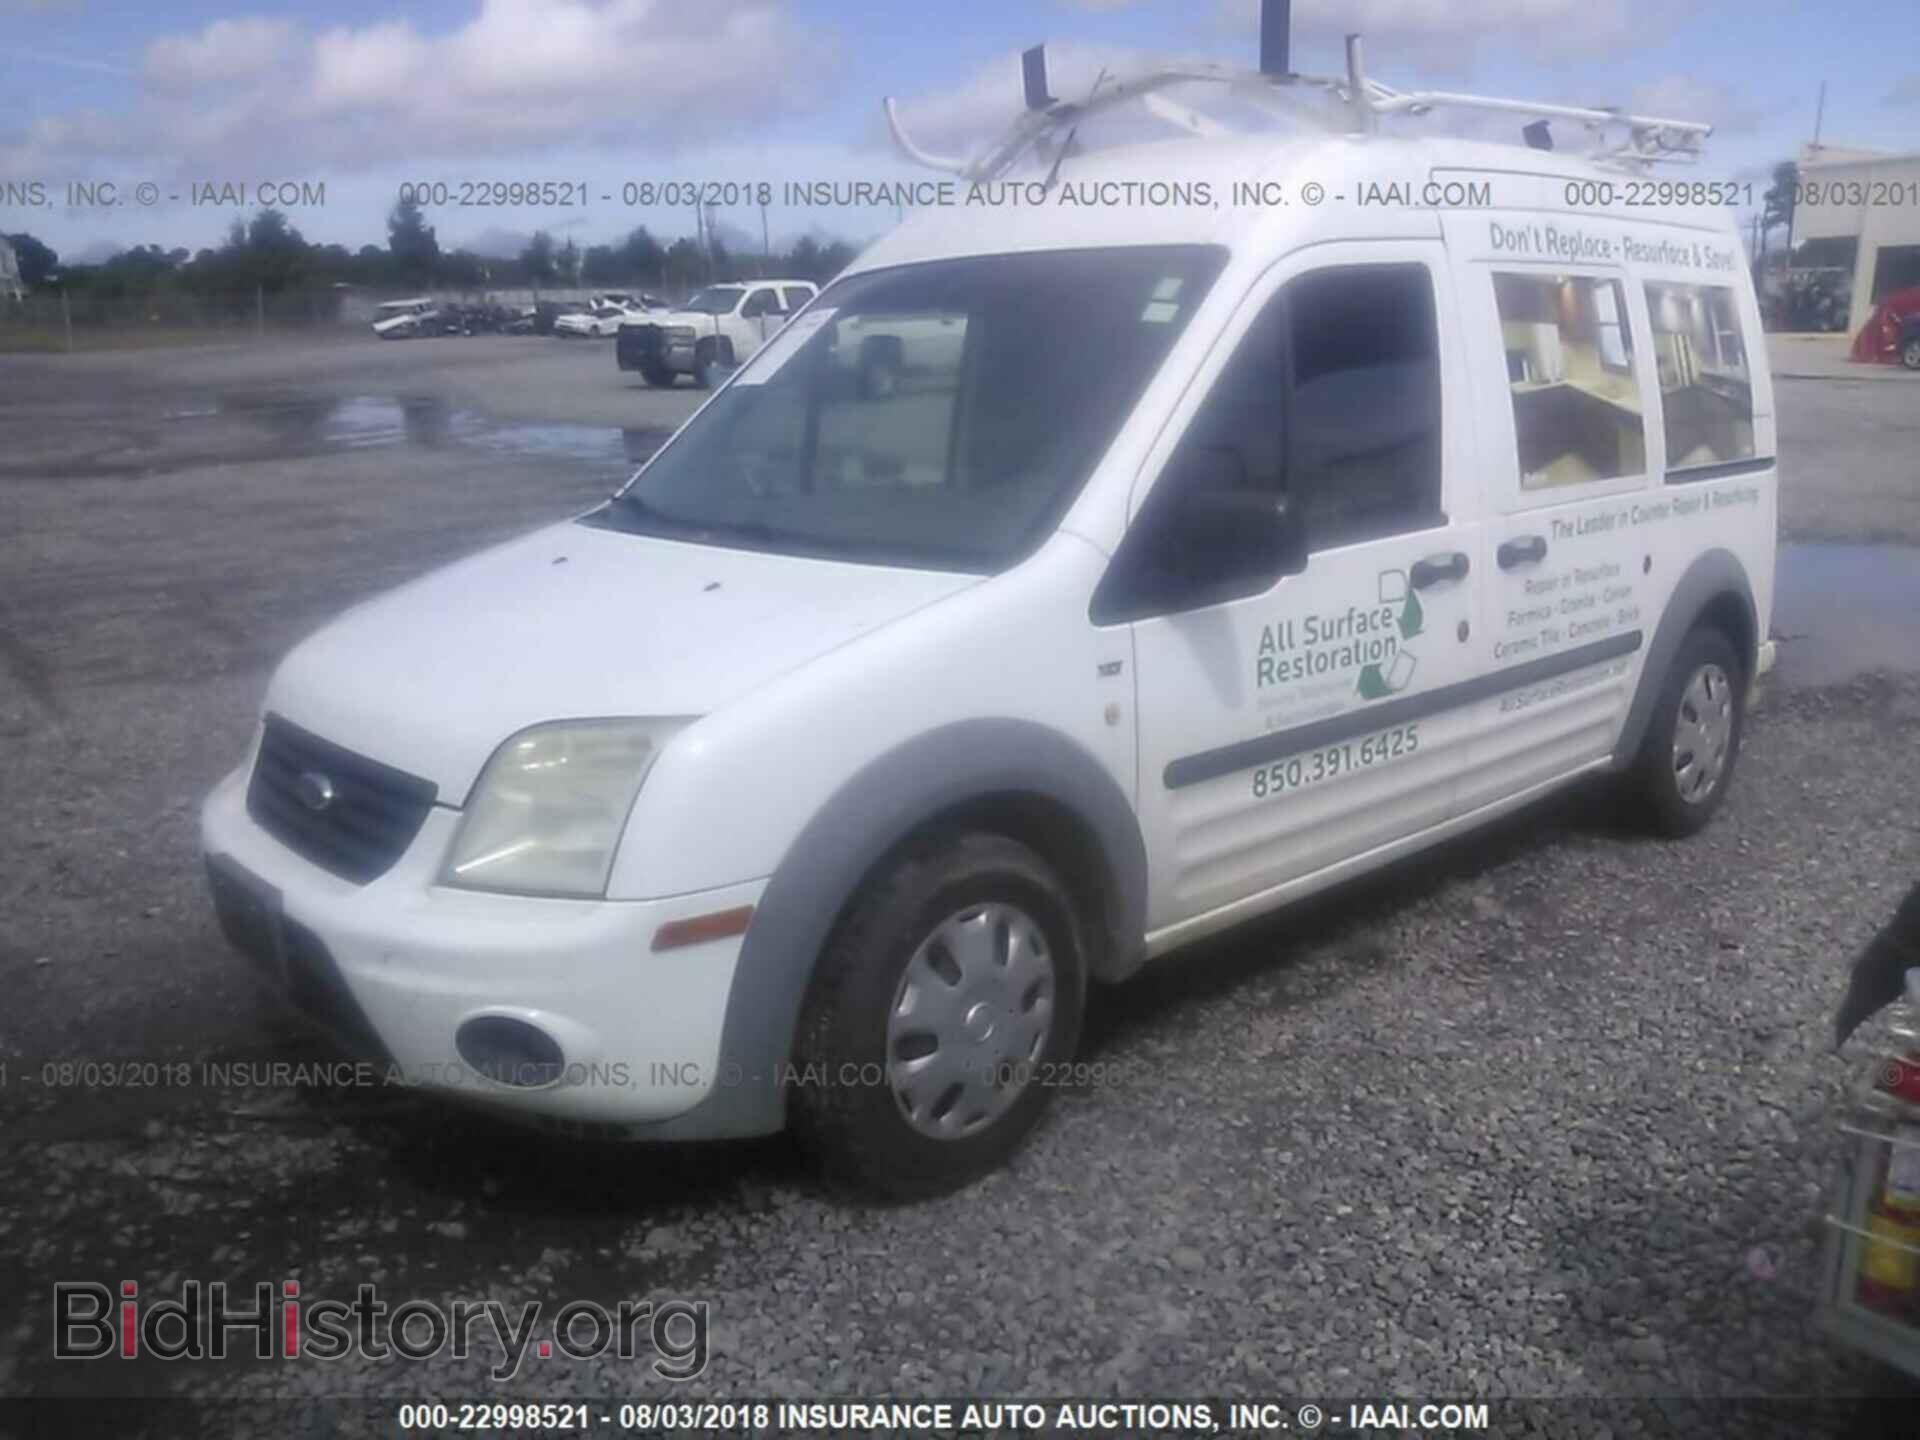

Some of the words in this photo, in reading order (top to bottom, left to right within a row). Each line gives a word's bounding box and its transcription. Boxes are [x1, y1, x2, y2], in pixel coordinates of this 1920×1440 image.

[1490, 222, 1541, 252] Don't
[1548, 227, 1612, 262] Replace
[1624, 236, 1690, 266] Resurface
[1259, 621, 1296, 655] All
[1304, 607, 1393, 646] Surface
[1257, 635, 1397, 689] Restoration
[1253, 724, 1419, 798] 850.391.6425
